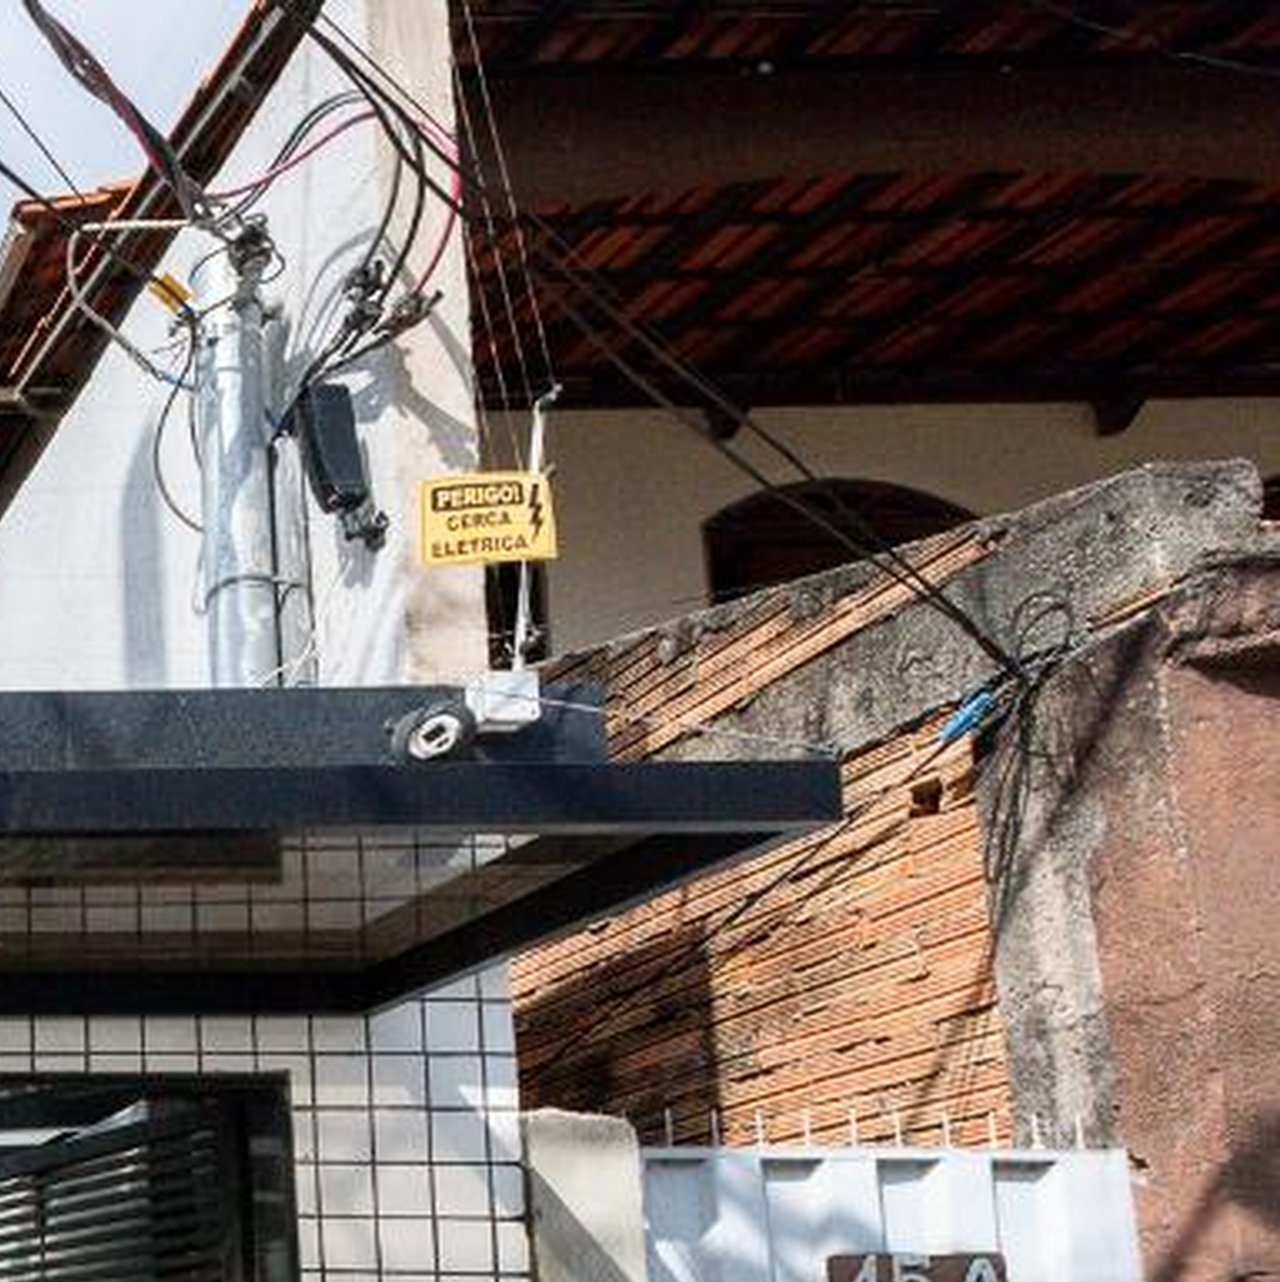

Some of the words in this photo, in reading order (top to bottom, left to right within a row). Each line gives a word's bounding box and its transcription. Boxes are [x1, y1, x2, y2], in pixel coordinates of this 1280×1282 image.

[437, 483, 521, 508] PERIGO!
[446, 511, 513, 532] CERCA
[432, 534, 530, 558] ELETRICA
